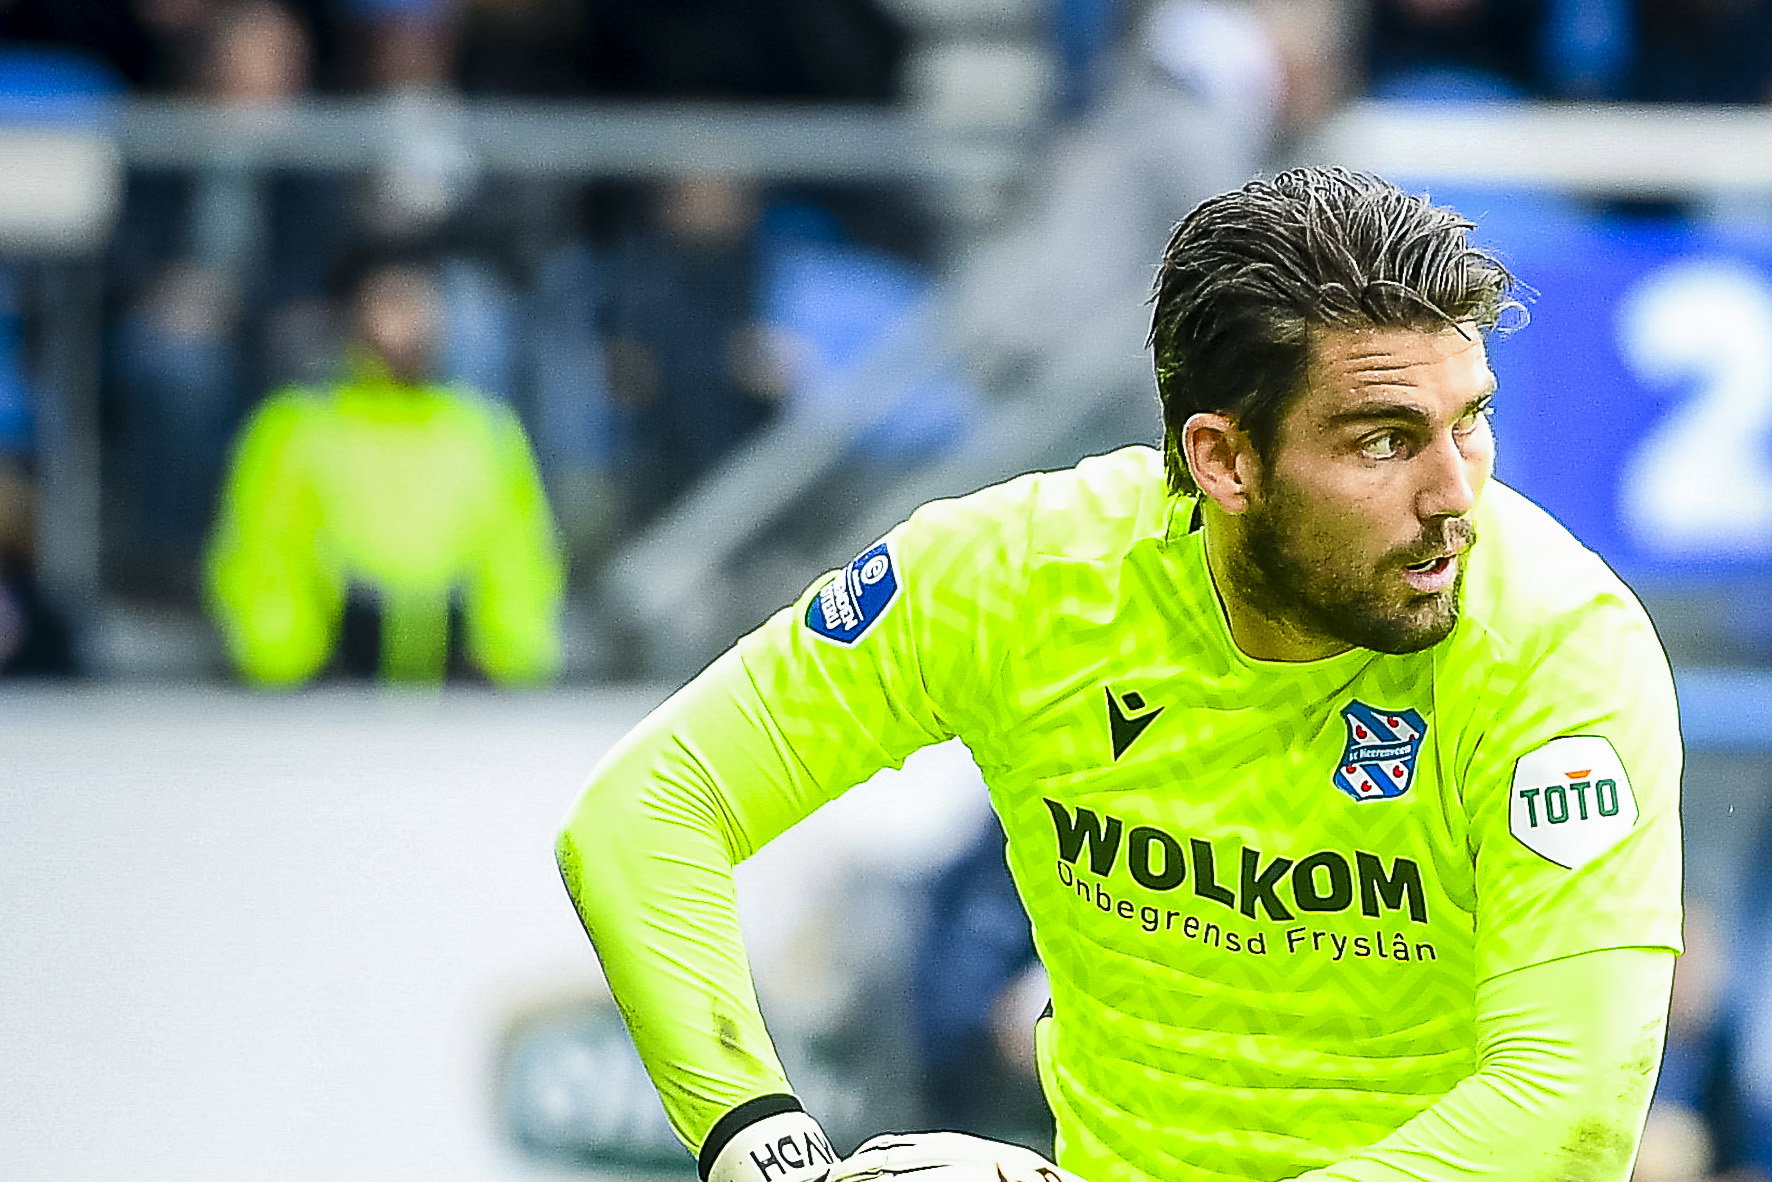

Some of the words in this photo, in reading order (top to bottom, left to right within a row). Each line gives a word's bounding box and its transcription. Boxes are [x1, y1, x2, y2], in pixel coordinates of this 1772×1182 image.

[1519, 776, 1619, 829] TOTO
[1043, 798, 1428, 924] WOLKOM
[1057, 860, 1266, 955] Onbegrensd
[1286, 926, 1436, 962] Fryslân
